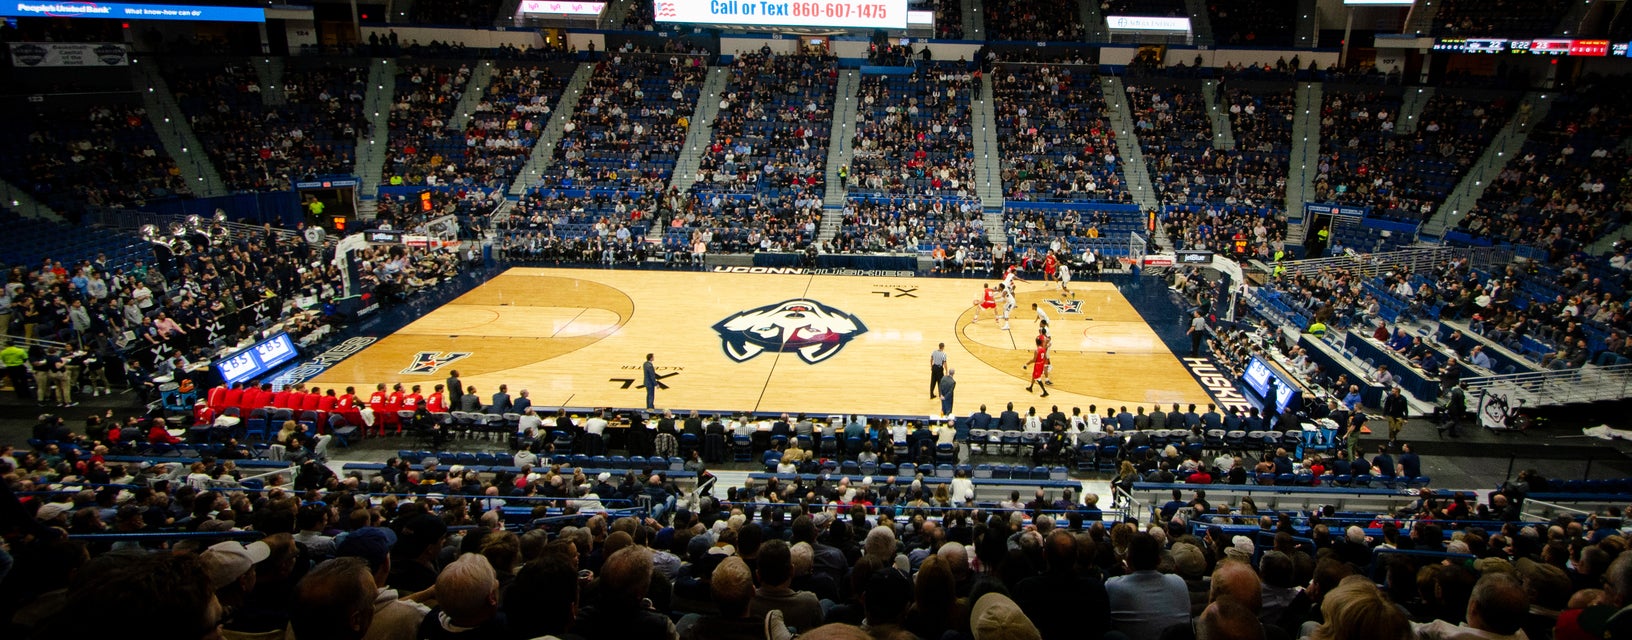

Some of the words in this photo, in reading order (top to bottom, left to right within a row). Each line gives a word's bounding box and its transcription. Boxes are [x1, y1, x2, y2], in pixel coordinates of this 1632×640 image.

[18, 4, 56, 12] People's
[711, 0, 737, 14] Call
[742, 3, 756, 15] or
[760, 2, 788, 16] Text
[793, 2, 887, 19] 860-607-1475
[1184, 254, 1206, 262] jetBlue
[714, 266, 802, 274] UCONN
[254, 303, 270, 320] XL
[206, 322, 225, 340] XL
[151, 343, 172, 364] XL
[256, 339, 282, 356] CBS
[223, 354, 248, 372] CBS
[1182, 358, 1263, 419] HUSKIE
